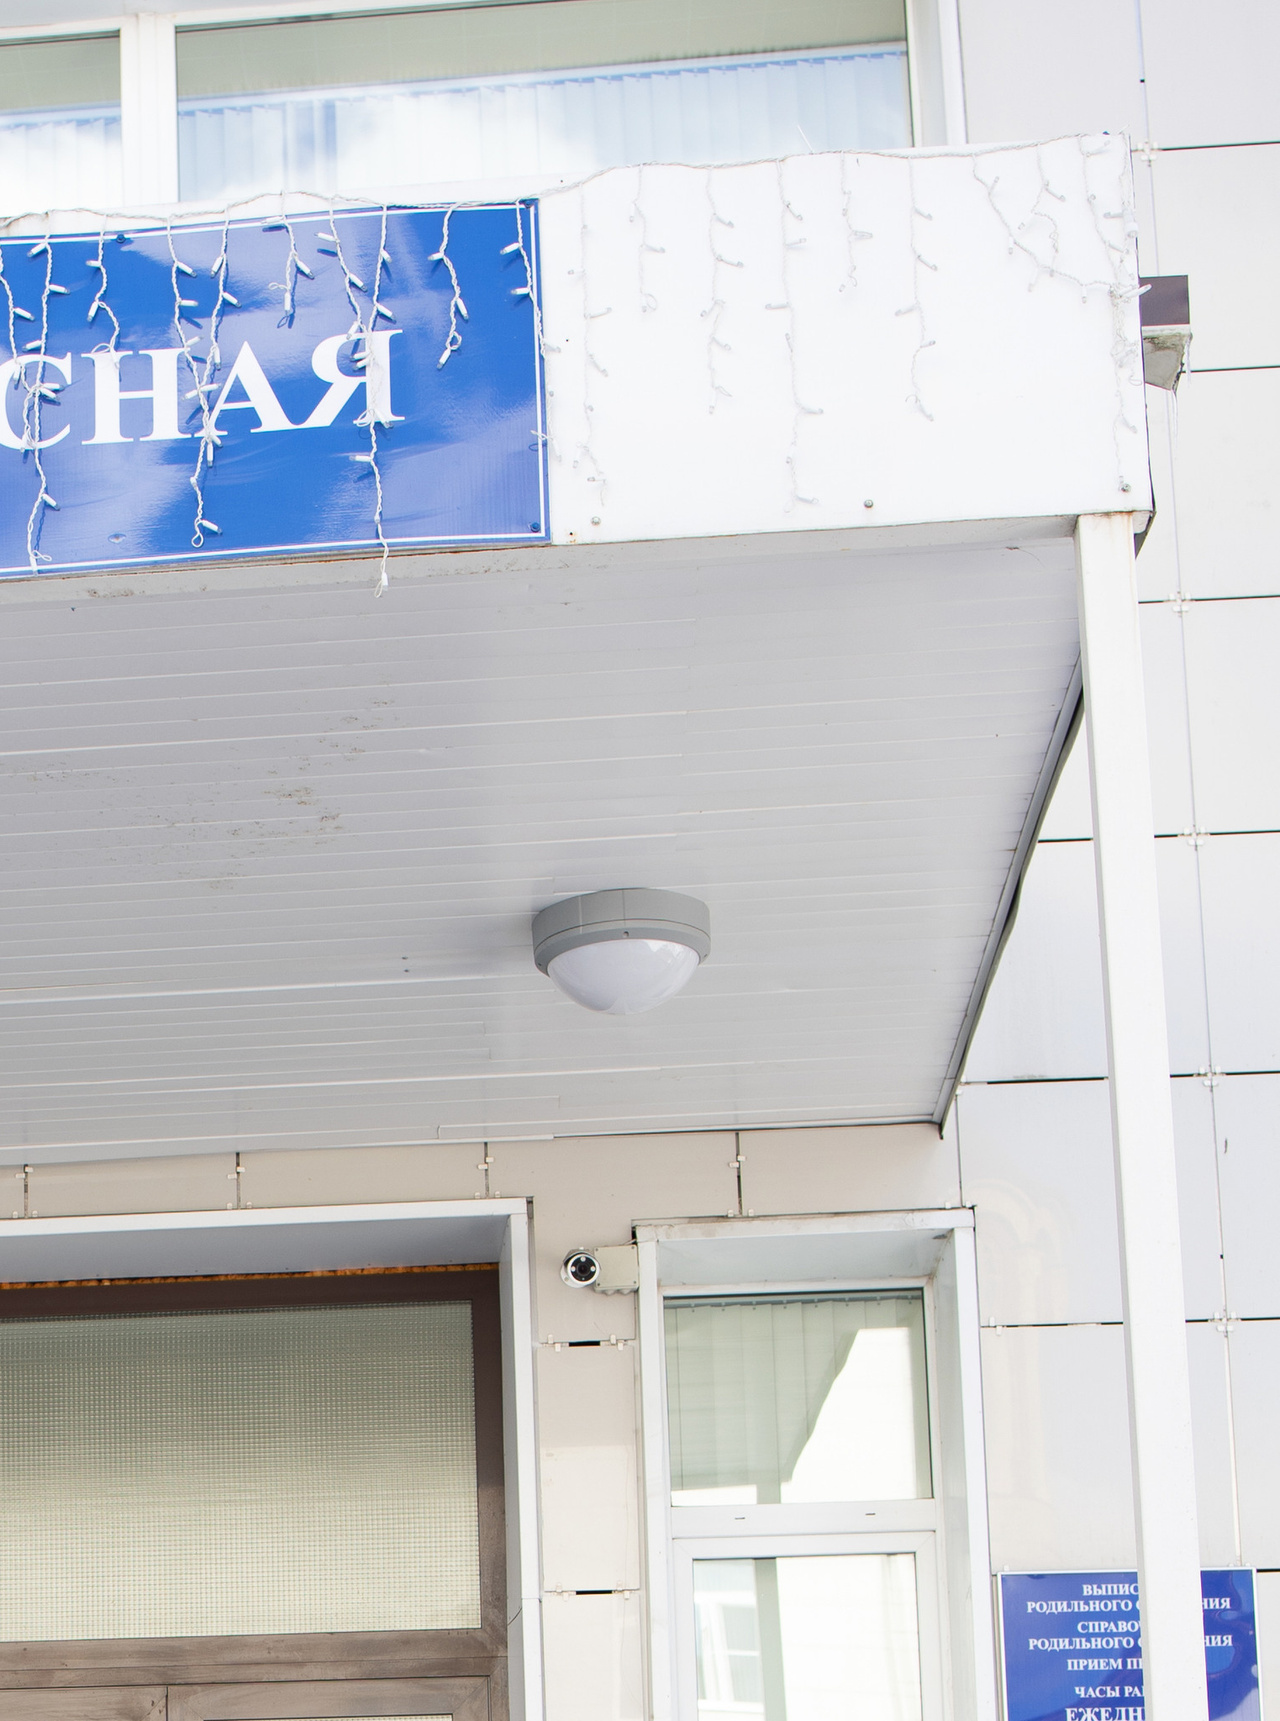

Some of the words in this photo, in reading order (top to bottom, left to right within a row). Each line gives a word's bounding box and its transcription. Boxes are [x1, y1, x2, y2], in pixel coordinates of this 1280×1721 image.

[1082, 1584, 1138, 1596] ВЫПИС
[1027, 1601, 1133, 1614] РОДИЛЬНОГО
[1077, 1621, 1142, 1633] СПРАВО
[1028, 1637, 1134, 1651] РОДИЛЬНОГО
[1067, 1659, 1122, 1670] ПРИЕМ
[1074, 1686, 1120, 1697] ЧАСЫ
